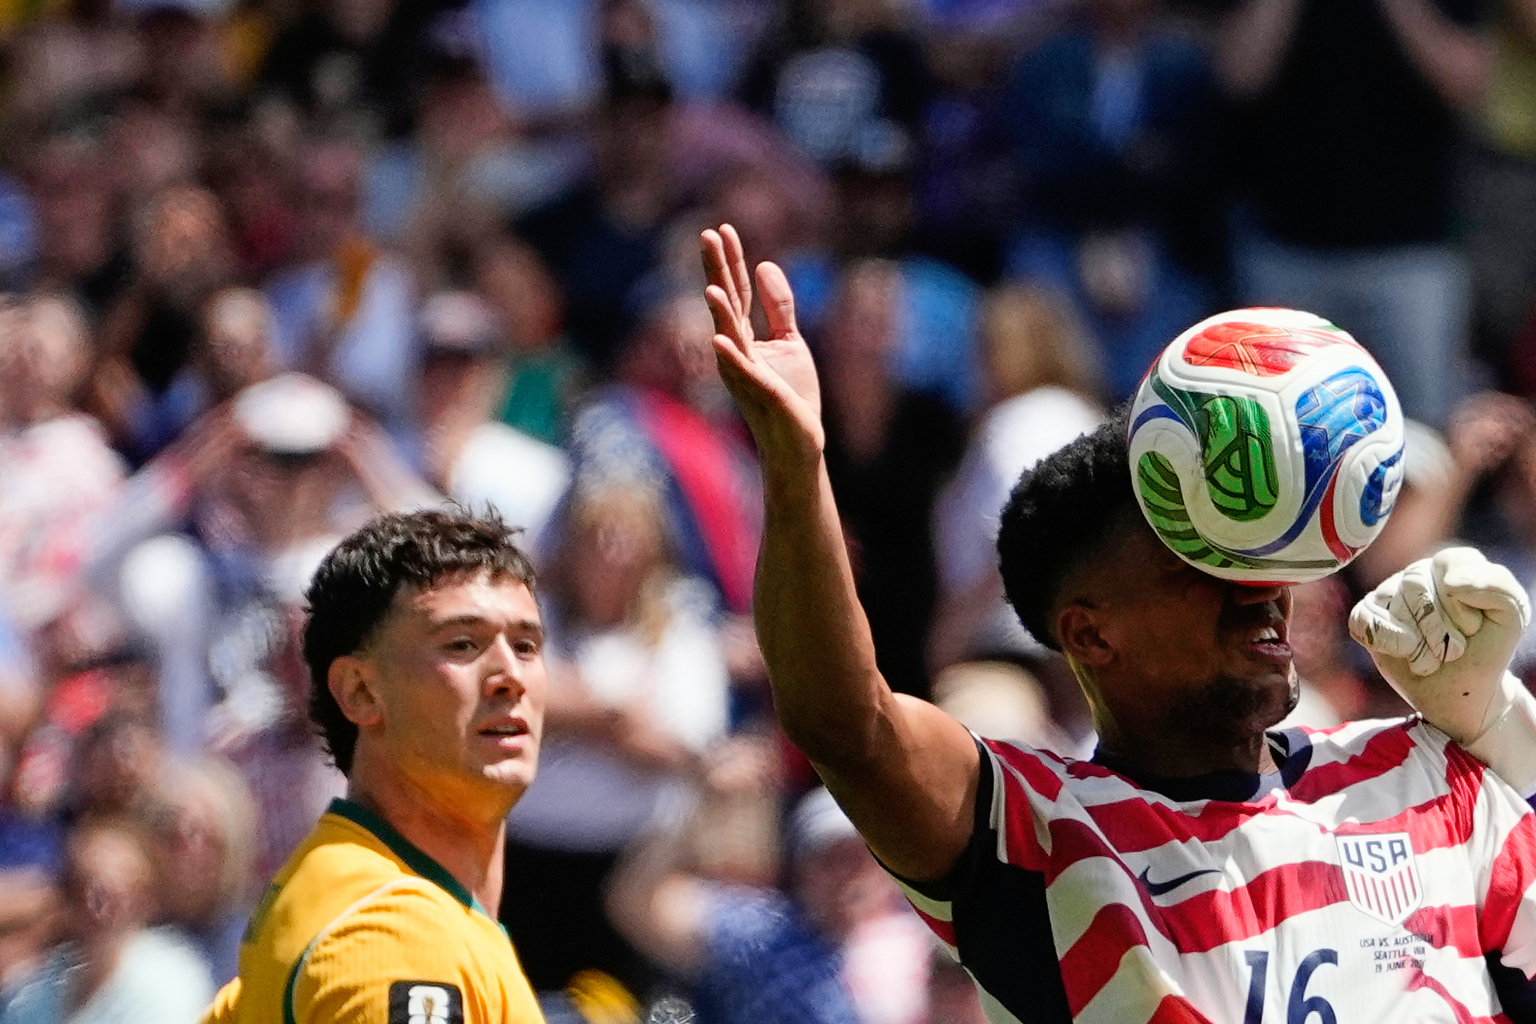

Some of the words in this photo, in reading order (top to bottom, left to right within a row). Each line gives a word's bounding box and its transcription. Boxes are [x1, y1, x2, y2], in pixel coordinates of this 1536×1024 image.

[1343, 839, 1408, 873] USA
[1360, 937, 1375, 948] USA
[1393, 933, 1433, 947] AUSTRALIA
[1414, 946, 1425, 955] WA
[1375, 963, 1383, 973] 19
[1386, 960, 1406, 972] JUNE
